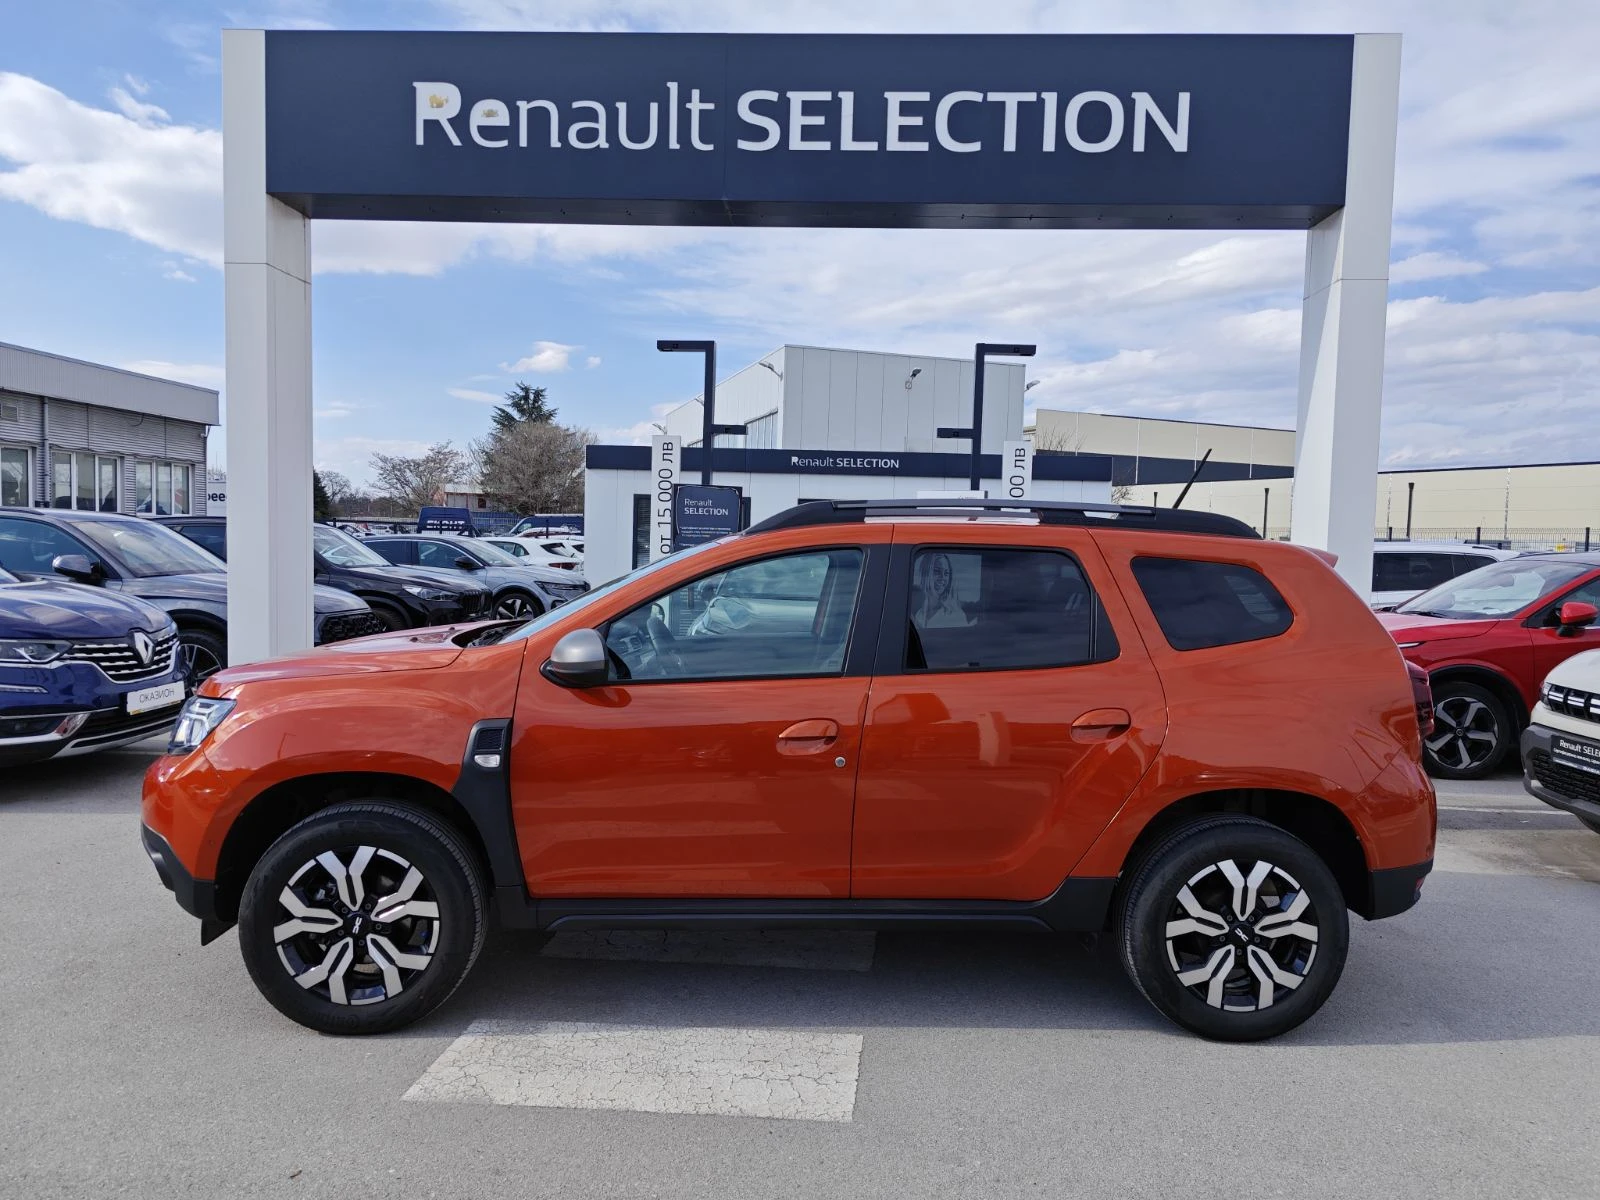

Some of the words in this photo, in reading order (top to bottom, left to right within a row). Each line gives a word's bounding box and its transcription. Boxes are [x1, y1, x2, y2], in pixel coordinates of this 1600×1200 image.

[412, 81, 715, 151] Renault
[736, 89, 1191, 154] SELECTION
[791, 456, 834, 467] Renault
[836, 457, 900, 469] SELECTION
[657, 468, 673, 503] 000
[684, 498, 713, 507] Renault
[684, 507, 729, 516] SELECTION
[657, 508, 672, 528] 15
[139, 687, 175, 704] ОКАЗИОН
[1559, 739, 1582, 753] Renault
[1582, 745, 1600, 758] SELE
